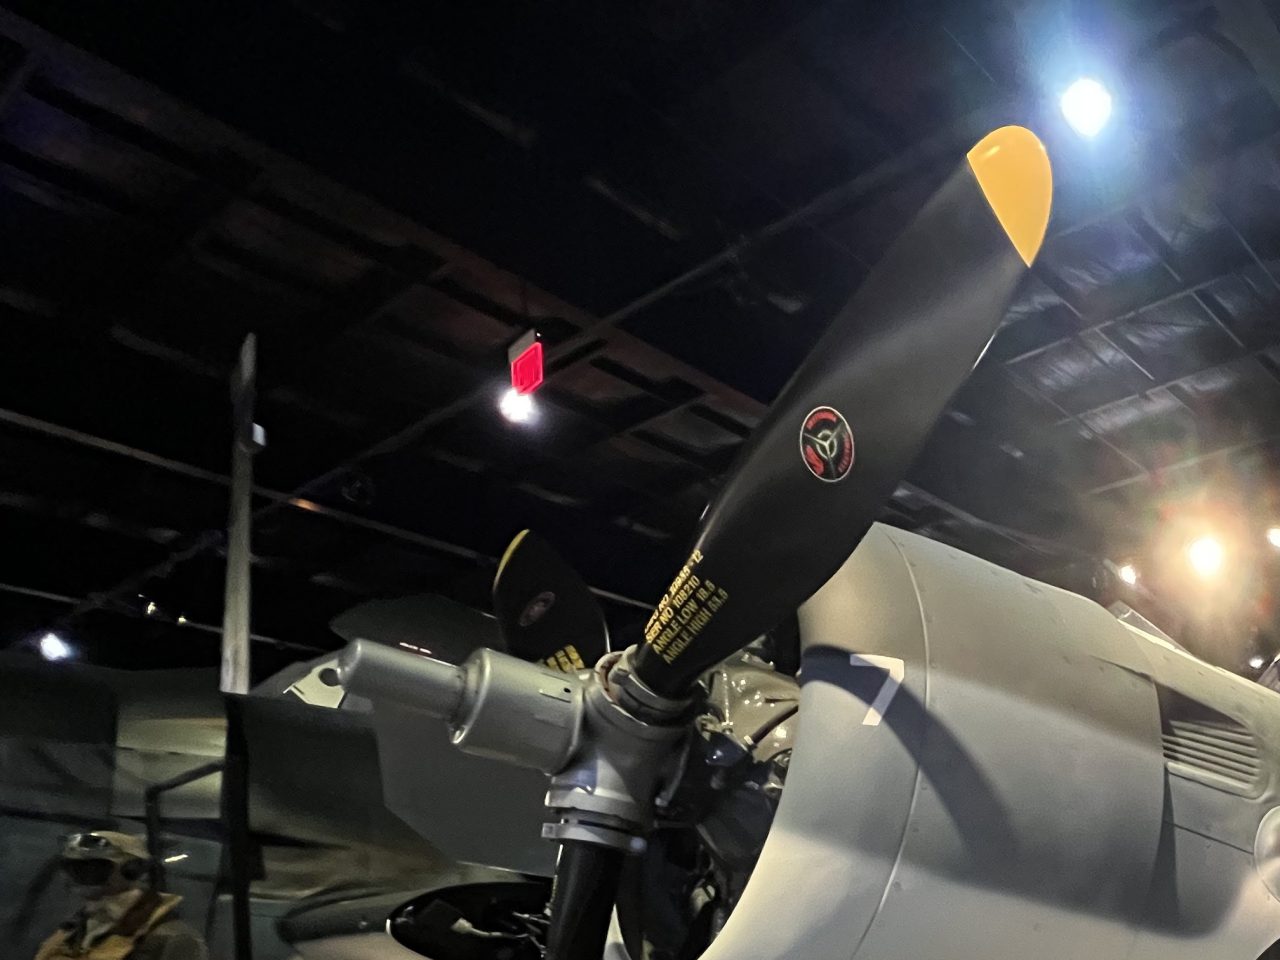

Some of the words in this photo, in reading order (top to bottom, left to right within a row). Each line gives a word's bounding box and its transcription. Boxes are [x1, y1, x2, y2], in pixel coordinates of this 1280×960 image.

[652, 619, 682, 655] ANGLE
[676, 598, 699, 626] LOW
[659, 606, 674, 625] NO
[662, 630, 693, 665] ANGLE
[686, 607, 713, 636] HIGH
[849, 653, 905, 726] 7
